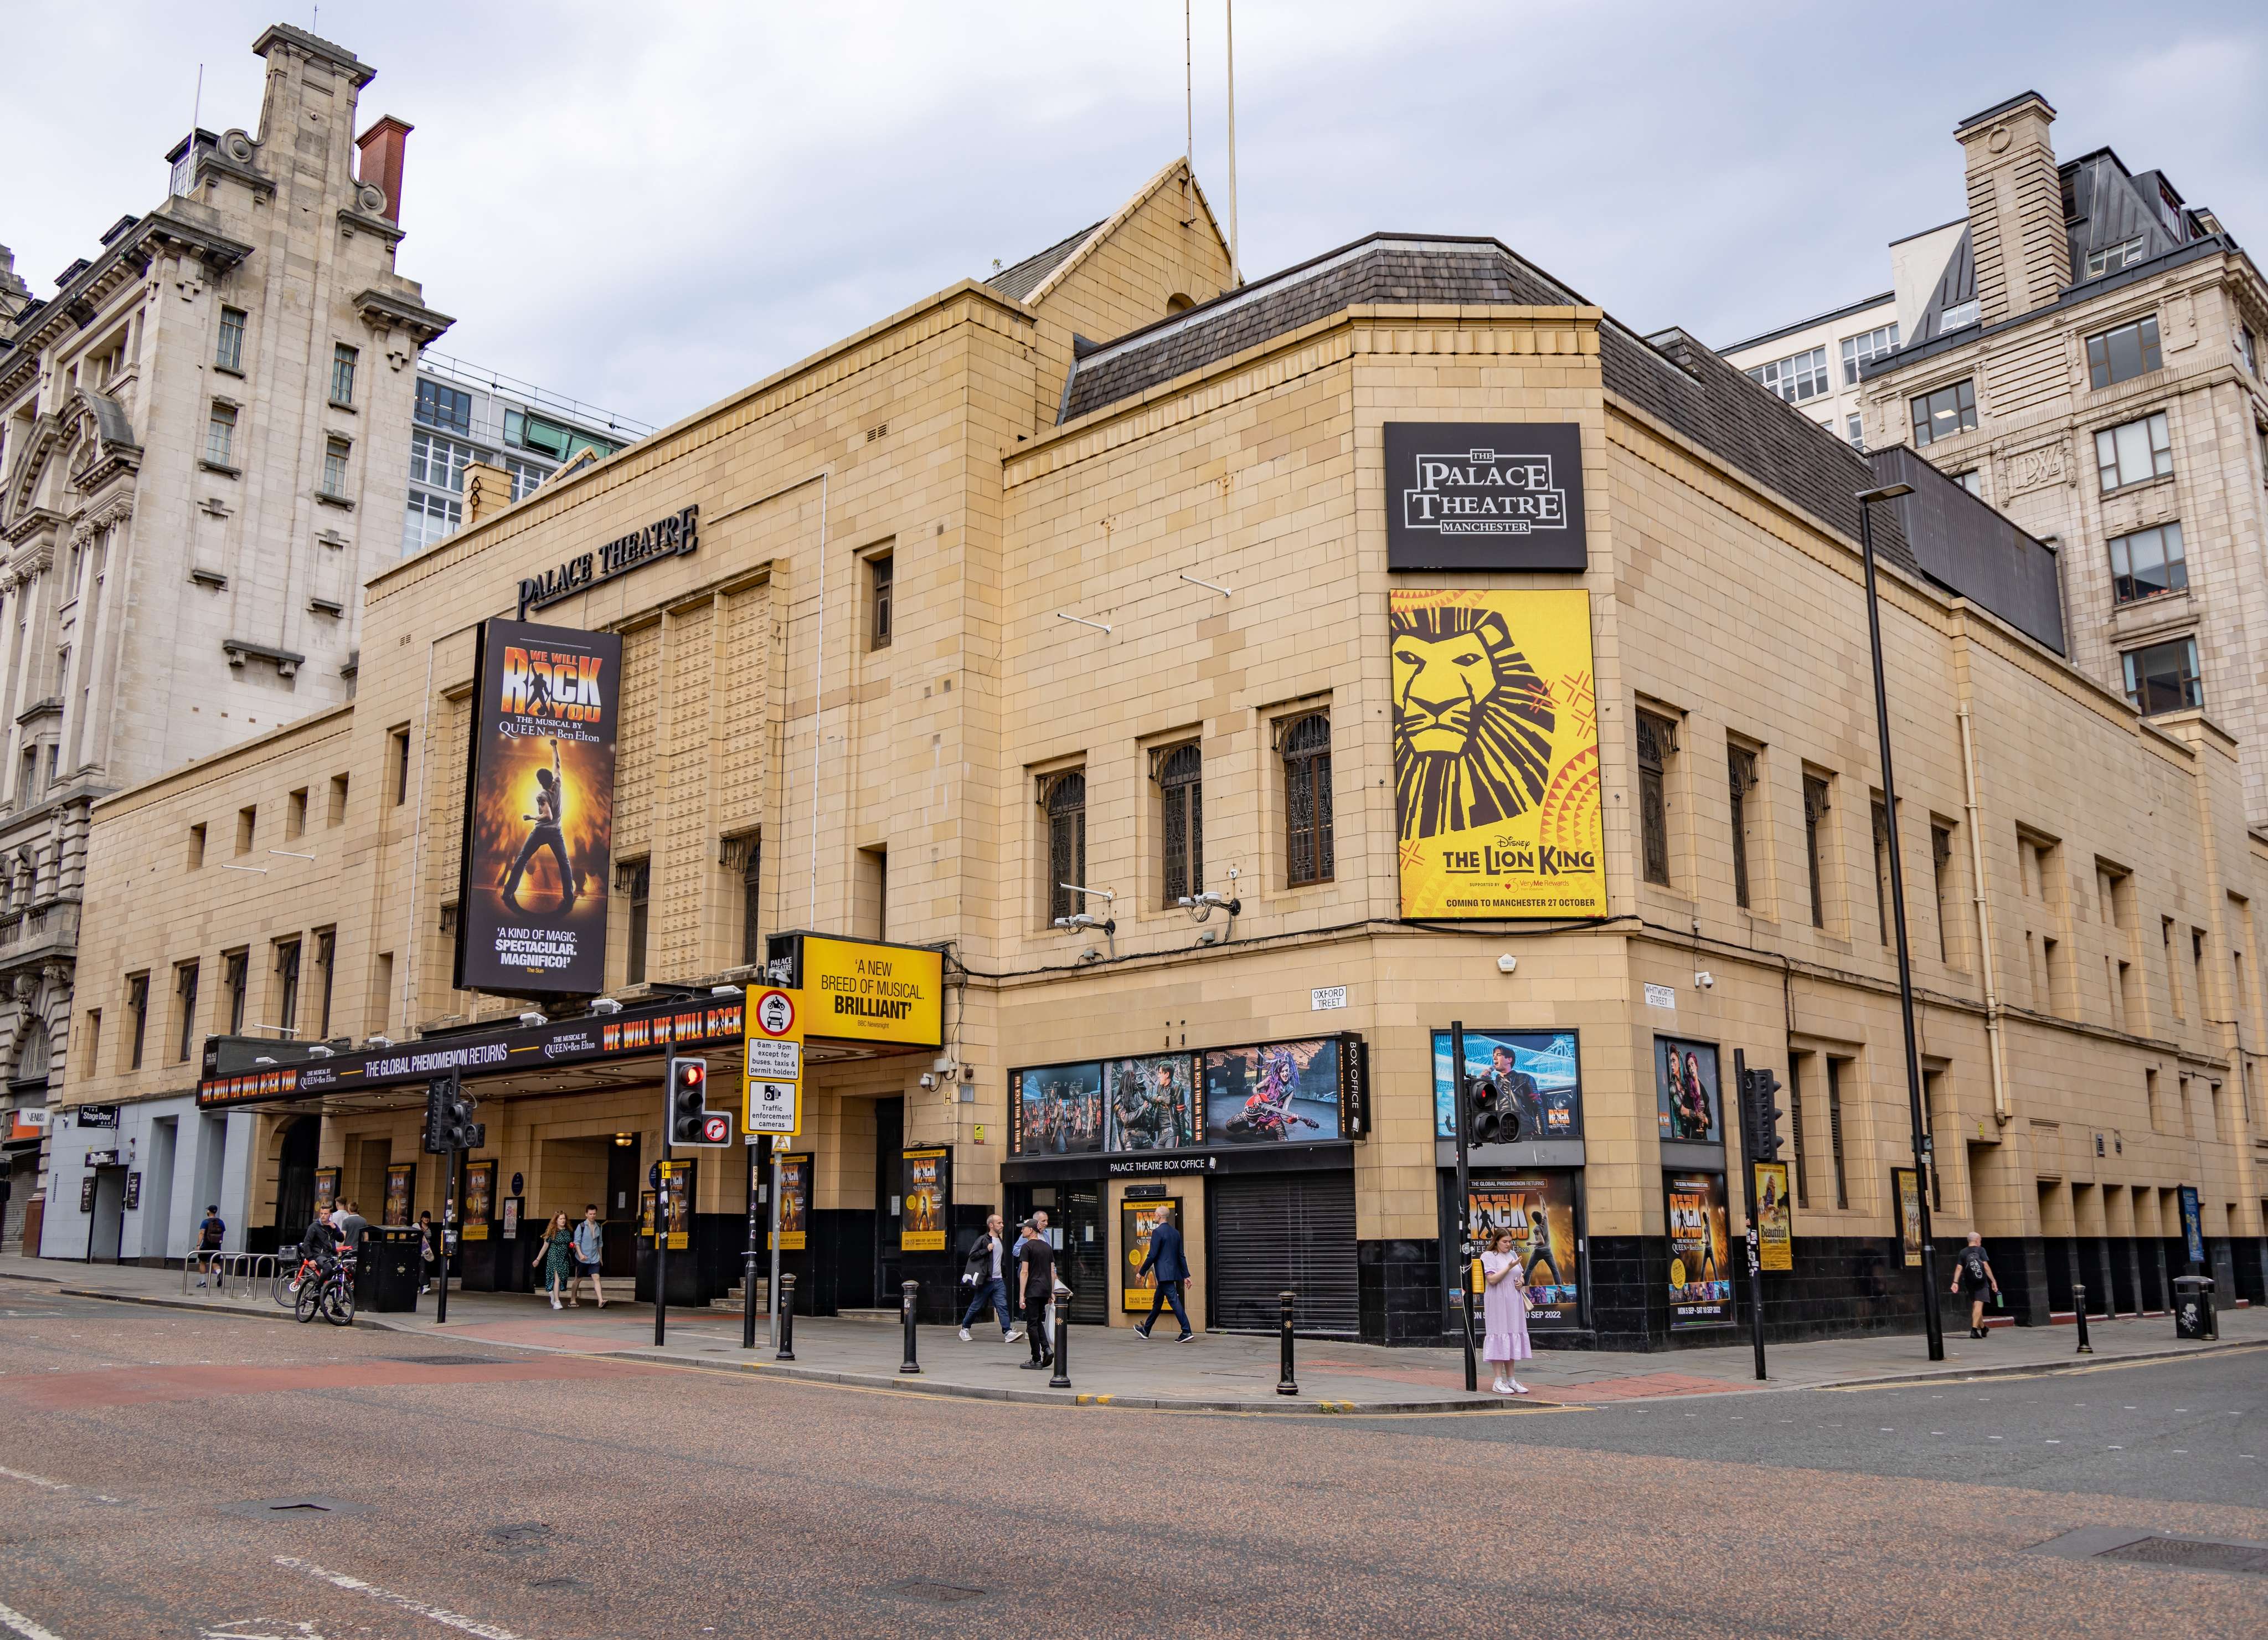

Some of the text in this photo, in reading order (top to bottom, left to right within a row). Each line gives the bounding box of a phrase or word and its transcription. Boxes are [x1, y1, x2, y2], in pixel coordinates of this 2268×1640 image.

[1422, 462, 1548, 490] PALACE
[1413, 493, 1560, 519] THEATRE
[1443, 522, 1528, 532] MANCHESTER
[517, 503, 699, 621] PALACE THEATRE
[530, 650, 578, 665] WE WILL
[501, 646, 602, 716] ROCK
[551, 702, 601, 723] YOU
[535, 718, 570, 728] MUSICAL
[499, 721, 600, 742] QUEEN Ben Elton
[1442, 851, 1480, 868] THE
[1446, 898, 1595, 907] COMING TO MANCHESTER 27 OCTOBER
[508, 928, 530, 939] KIND
[532, 929, 544, 939] OF
[547, 930, 578, 942] MAGIC.
[495, 939, 577, 955] SPECTACULAR.
[770, 957, 792, 967] PALACE
[868, 960, 892, 976] NEW
[822, 975, 925, 1000] BREED OF MUSICAL.
[1314, 989, 1344, 999] OXFORD
[1645, 984, 1674, 998] WHITWORTH
[1650, 995, 1667, 1005] STREET
[834, 995, 912, 1020] BRILLIANT’
[603, 1006, 742, 1051] WE WILL WE WILL ROCK
[868, 1021, 889, 1030] Newsnight
[563, 1034, 581, 1042] MUSICAL
[545, 1040, 595, 1058] QUEEN Ben Elton
[365, 1043, 507, 1077] THE GLOBAL PHENOMENON RETURNS
[750, 1067, 771, 1076] permit
[202, 1070, 297, 1102] WE WILL WE WILL ROCK YOU
[300, 1076, 317, 1089] QUEEN
[945, 1093, 951, 1104] H
[27, 1113, 43, 1122] VENUS
[83, 1112, 99, 1121] Stage
[1111, 1160, 1204, 1171] PALACE THEATRE BOX OFFICE
[1669, 1194, 1702, 1238] ROCK
[1137, 1212, 1158, 1236] ROC
[1687, 1227, 1702, 1238] YOU
[1761, 1225, 1786, 1238] Beautiful
[1672, 1243, 1687, 1254] QUEEN
